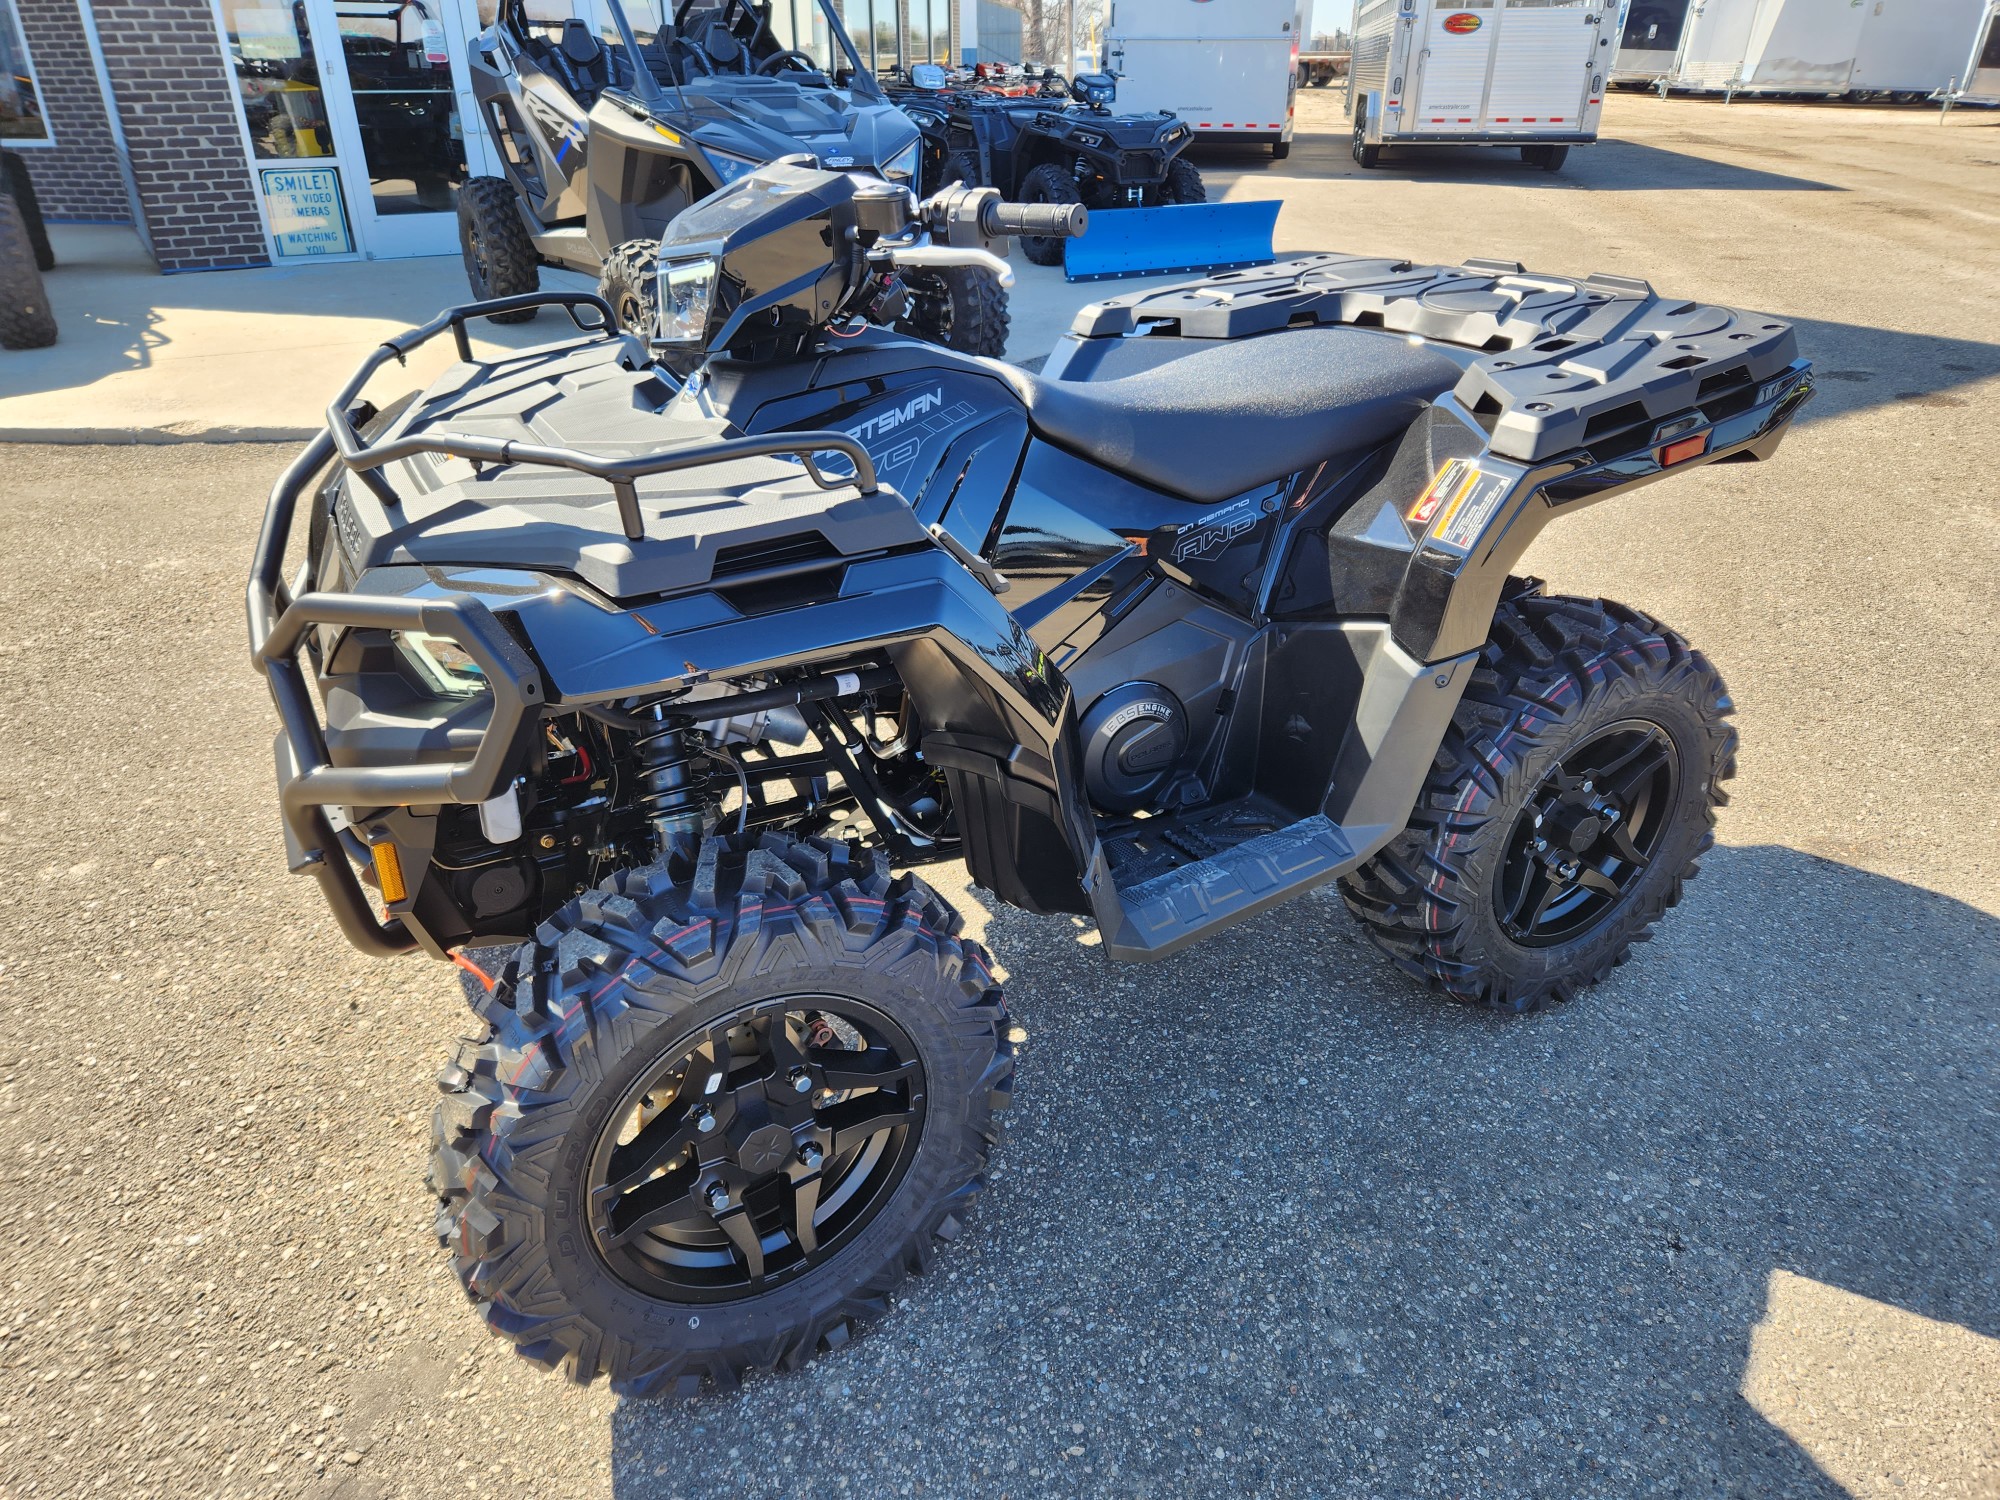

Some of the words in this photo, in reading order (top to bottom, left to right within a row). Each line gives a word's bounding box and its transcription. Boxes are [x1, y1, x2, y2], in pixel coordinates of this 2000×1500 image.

[523, 90, 587, 153] RZR
[274, 175, 329, 192] SMILE!
[277, 194, 297, 205] OUR
[302, 193, 332, 203] VIDEO
[284, 206, 331, 218] CAMERAS
[287, 231, 338, 244] WATCHING
[305, 245, 326, 255] YOU
[1198, 498, 1250, 526] DEMAND
[1177, 512, 1257, 563] AWD
[1106, 707, 1137, 733] EBS
[1138, 703, 1172, 718] ENGINE
[553, 1096, 608, 1259] DURO
